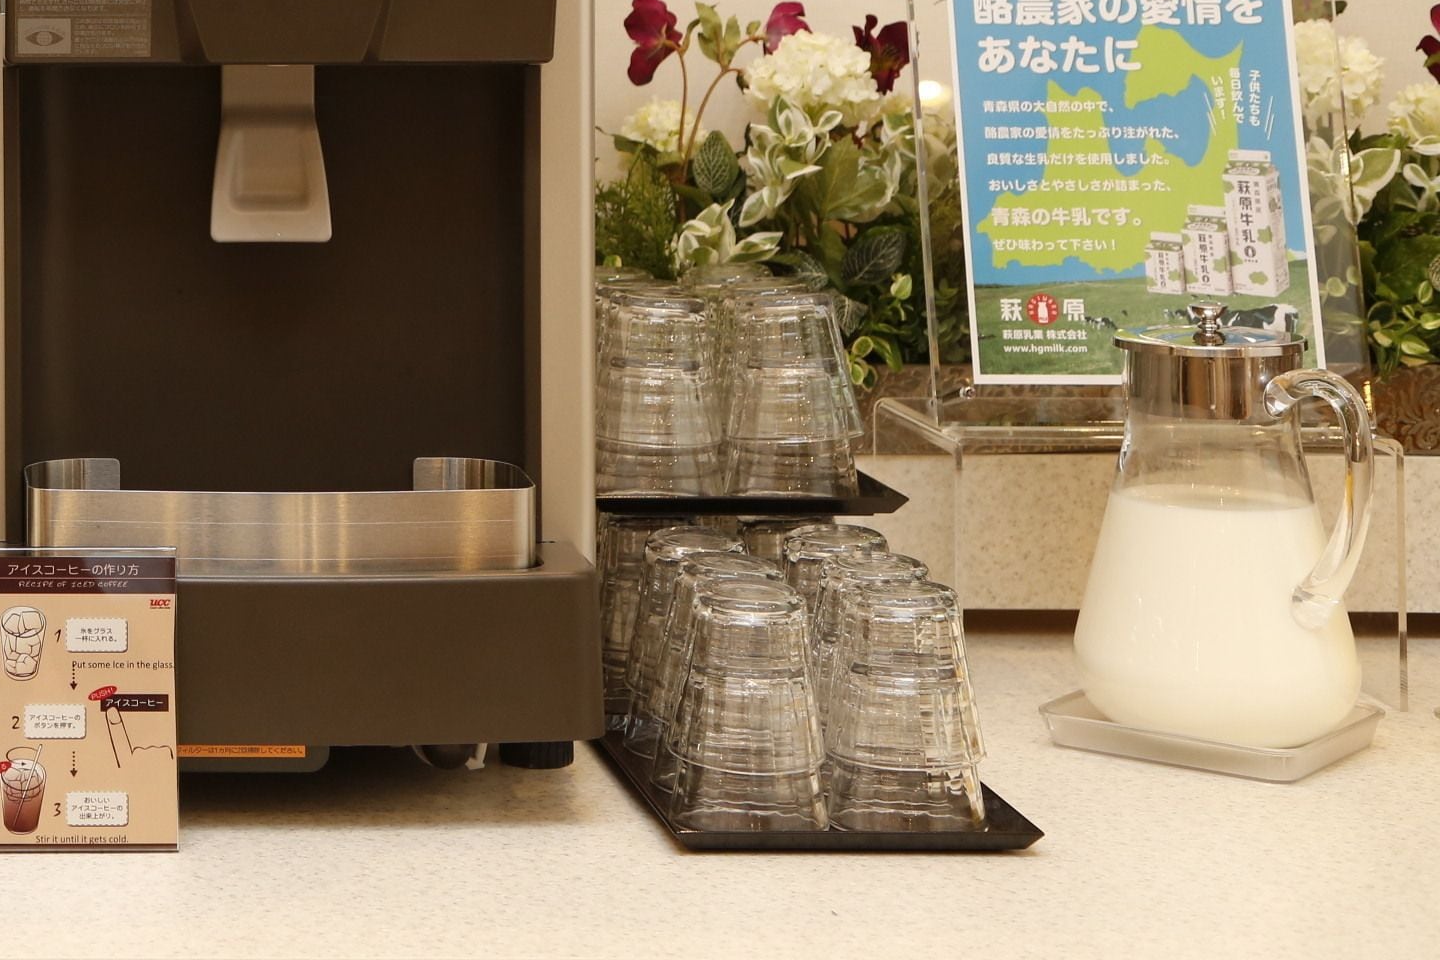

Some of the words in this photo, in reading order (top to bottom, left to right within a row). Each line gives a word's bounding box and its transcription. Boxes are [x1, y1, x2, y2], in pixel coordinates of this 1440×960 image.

[978, 35, 1142, 73] あなたに
[1229, 67, 1244, 124] 毎日飲んで
[1249, 69, 1261, 127] 子供たちも
[983, 100, 1114, 113] 青森県の大自然の中で、
[987, 153, 1170, 166] 良質な生乳だけを使用しました。
[988, 179, 1172, 191] おいしさとやさしさが詰まった、
[992, 207, 1142, 227] 青森の牛乳です。
[1237, 180, 1256, 243] 萩原牛乳
[993, 239, 1118, 251] ぜひ味わって下さい！
[1046, 329, 1088, 340] 株式会社
[1003, 343, 1088, 355] www.hgmilk.com
[8, 564, 140, 576] アイスコーヒーの作り方
[18, 580, 54, 588] RECIPE
[54, 629, 62, 643] 1
[73, 660, 87, 669] Put
[112, 660, 125, 669] Ice
[126, 660, 135, 669] in
[136, 660, 151, 669] the
[153, 660, 175, 671] glass.
[90, 687, 115, 701] PUSH!
[105, 699, 164, 707] アイスコーヒー
[12, 716, 20, 730] 2
[54, 803, 61, 817] 3
[35, 835, 51, 843] Stir
[52, 835, 59, 843] it
[60, 835, 80, 843] until
[81, 835, 87, 843] it
[88, 836, 107, 845] gets
[108, 835, 129, 843] cold.
